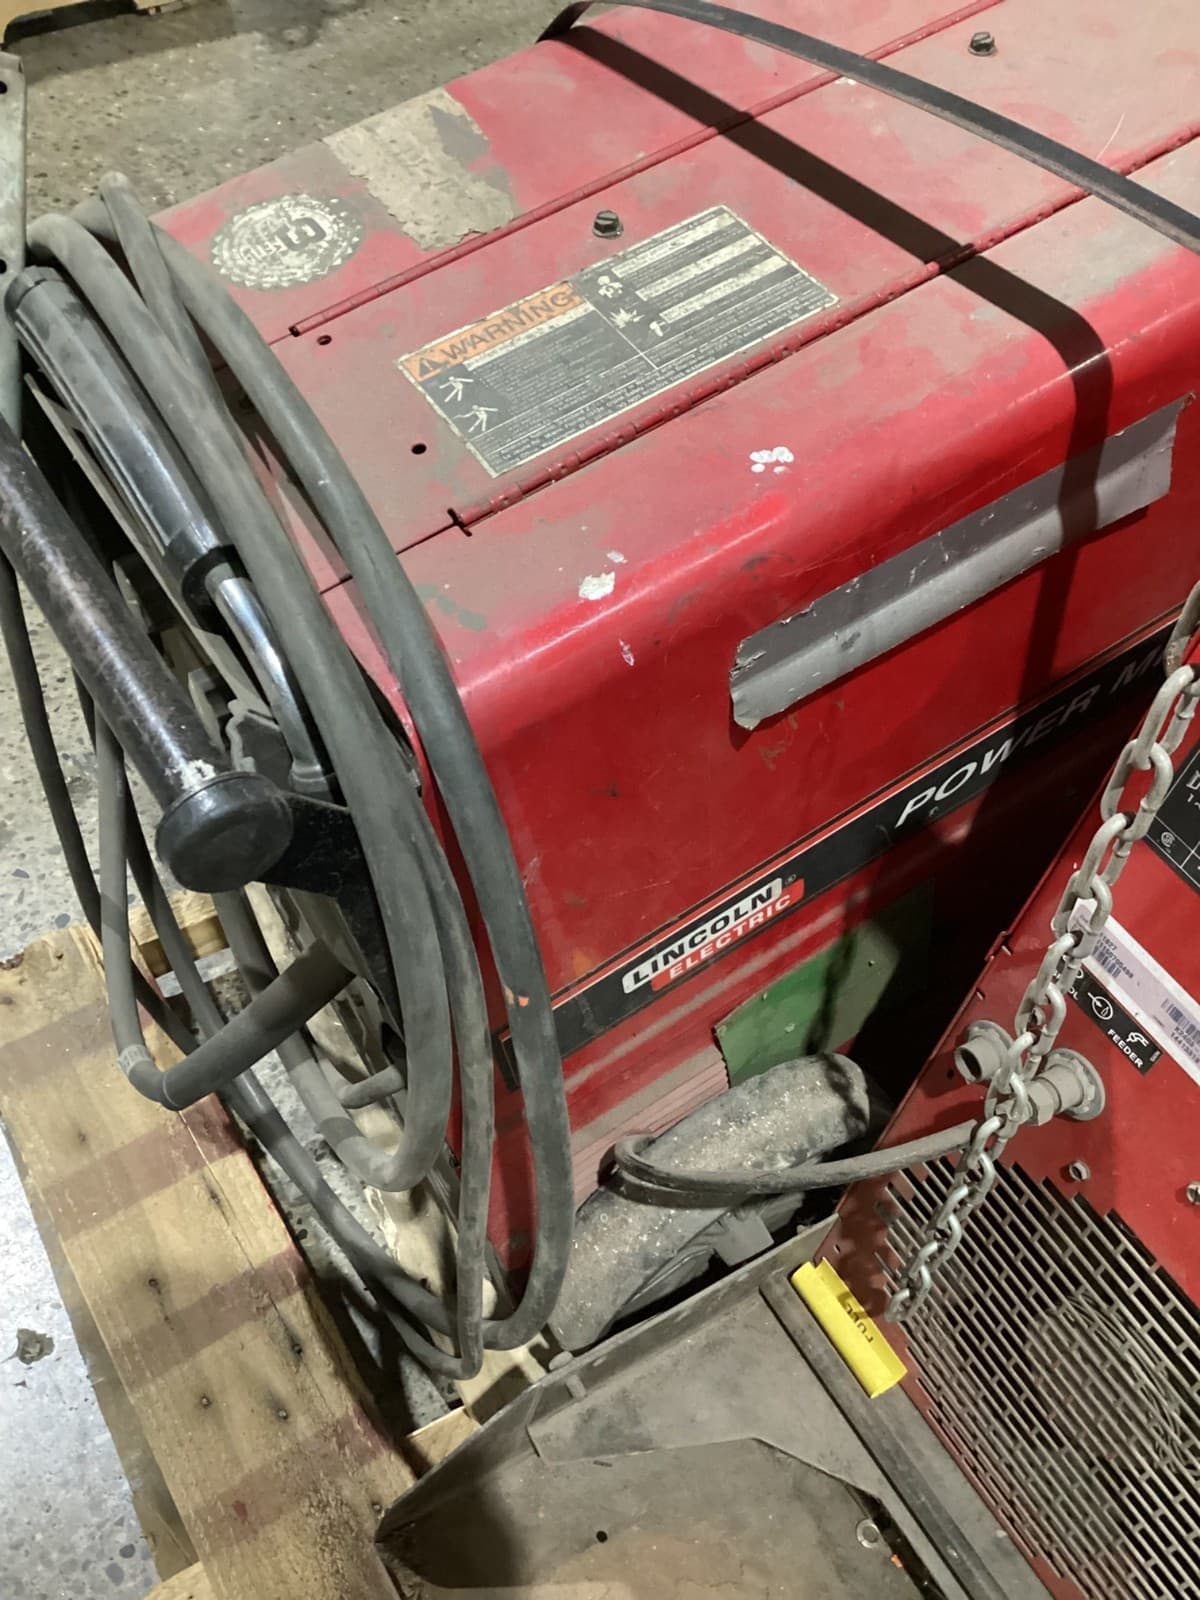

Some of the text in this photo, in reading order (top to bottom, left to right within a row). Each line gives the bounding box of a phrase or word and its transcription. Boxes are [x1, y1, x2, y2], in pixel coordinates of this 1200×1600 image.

[440, 291, 574, 360] WARNING
[895, 684, 1100, 828] POWER
[632, 885, 773, 985] LINCOLN
[668, 894, 791, 979] ELECTRIC
[1107, 1028, 1144, 1069] FEEDER
